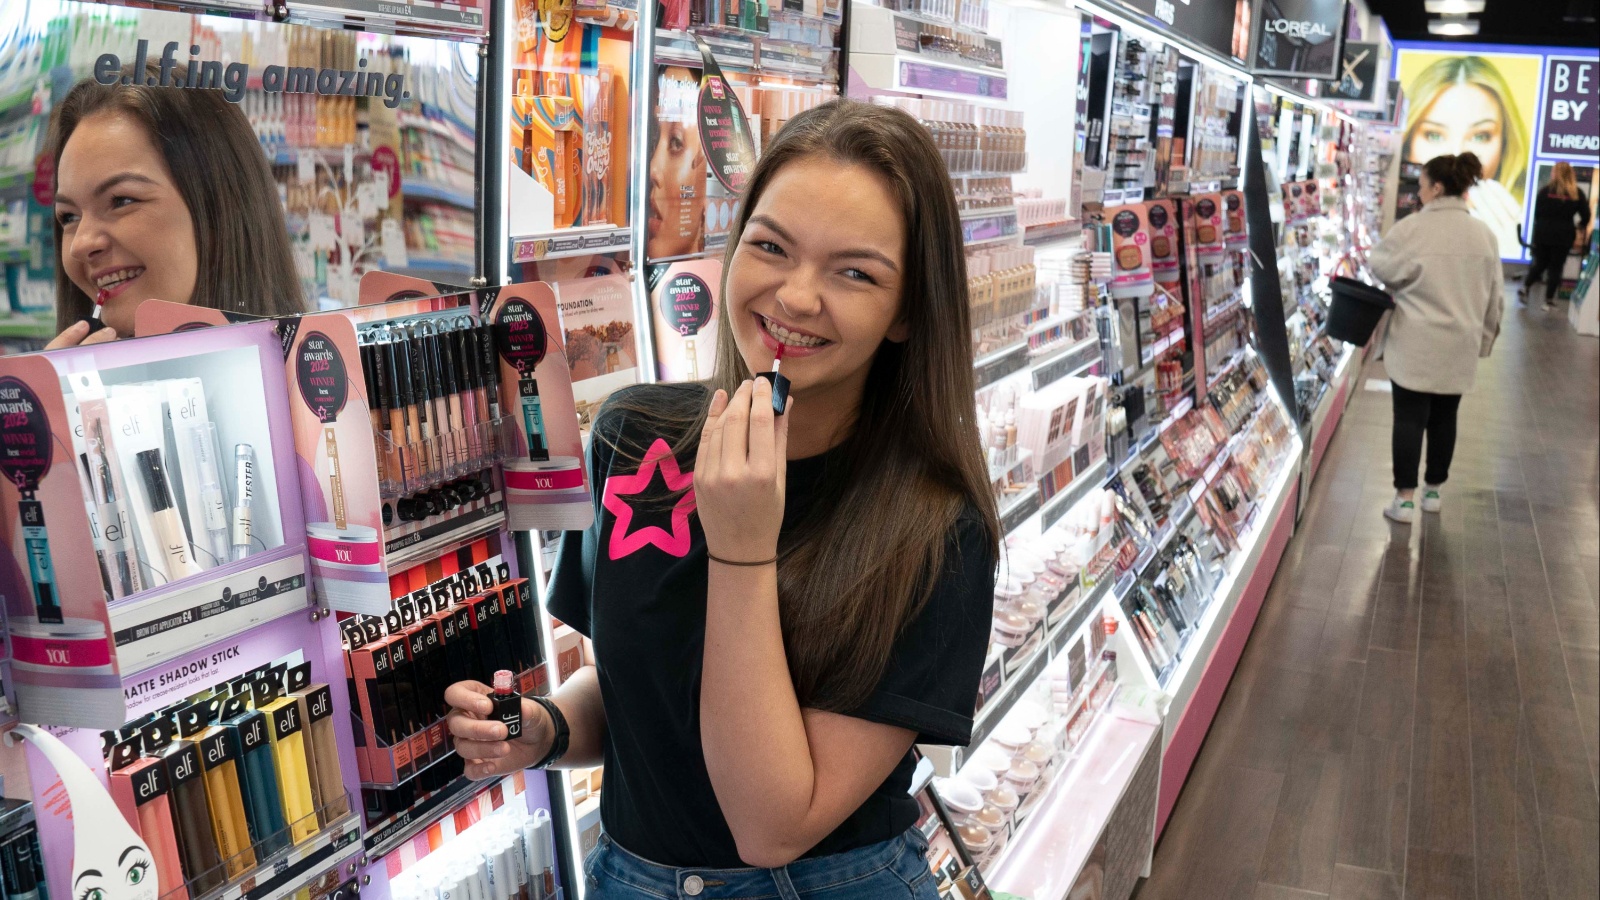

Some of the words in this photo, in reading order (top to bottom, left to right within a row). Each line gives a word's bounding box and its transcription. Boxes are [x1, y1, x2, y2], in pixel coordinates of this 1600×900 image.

[94, 39, 248, 103] e.l.f.ing
[262, 58, 410, 108] amazing.
[704, 106, 722, 114] WINNER
[1551, 100, 1588, 122] BY
[705, 117, 718, 126] best
[726, 152, 740, 162] star
[520, 244, 525, 254] 3
[529, 244, 534, 254] 2
[670, 284, 700, 294] awards
[676, 278, 692, 286] star
[508, 304, 524, 313] star
[503, 312, 533, 323] awards
[308, 340, 324, 350] star
[508, 334, 534, 343] WINNER
[304, 349, 334, 361] awards
[310, 377, 335, 386] WINNER
[524, 383, 533, 393] elf
[0, 388, 20, 399] star
[0, 399, 34, 414] wards
[180, 398, 196, 420] elf
[122, 416, 142, 436] elf
[2, 433, 36, 444] WINNER
[535, 478, 553, 488] YOU
[25, 506, 38, 522] elf
[105, 510, 127, 542] elf
[239, 518, 252, 537] elf
[170, 544, 187, 564] elf
[336, 550, 352, 561] YOU
[506, 590, 515, 607] elf
[521, 585, 530, 601] elf
[478, 606, 487, 622] elf
[490, 598, 499, 615] elf
[136, 626, 149, 638] BROW
[150, 624, 158, 634] LIFT
[159, 616, 182, 630] APPLICATOR
[183, 612, 193, 622] £4
[459, 612, 469, 630] elf
[427, 628, 437, 645] elf
[445, 621, 454, 638] elf
[413, 636, 423, 654] elf
[46, 650, 70, 664] YOU
[376, 652, 388, 670] elf
[393, 645, 404, 663] elf
[160, 658, 208, 686] SHADOW
[212, 645, 240, 665] STICK
[188, 678, 200, 686] looks
[312, 692, 327, 716] elf
[280, 707, 296, 733] elf
[503, 713, 520, 735] elf
[245, 720, 261, 746] elf
[208, 736, 227, 763] elf
[175, 752, 194, 780] elf
[139, 769, 159, 797] elf
[403, 813, 410, 825] £4
